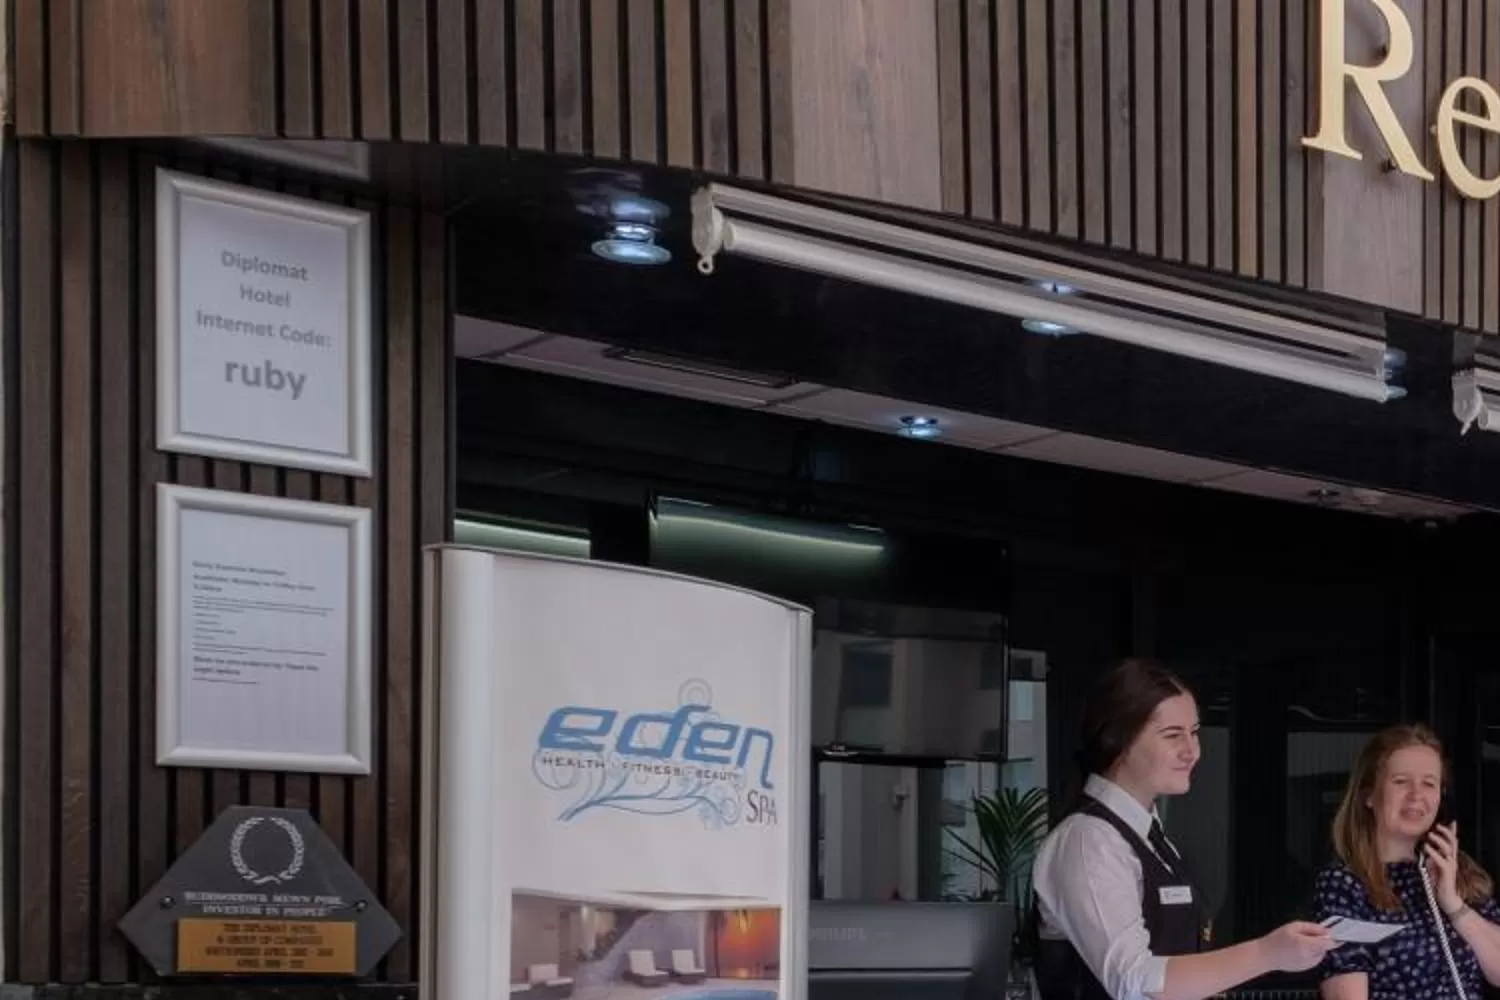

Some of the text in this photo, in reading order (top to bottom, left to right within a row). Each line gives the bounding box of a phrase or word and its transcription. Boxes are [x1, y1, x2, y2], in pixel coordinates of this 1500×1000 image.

[221, 251, 308, 281] Diplomat
[239, 284, 290, 308] Hotel
[196, 310, 275, 338] Internet
[224, 360, 306, 400] ruby
[539, 704, 774, 789] eden
[542, 757, 605, 769] HEALTH
